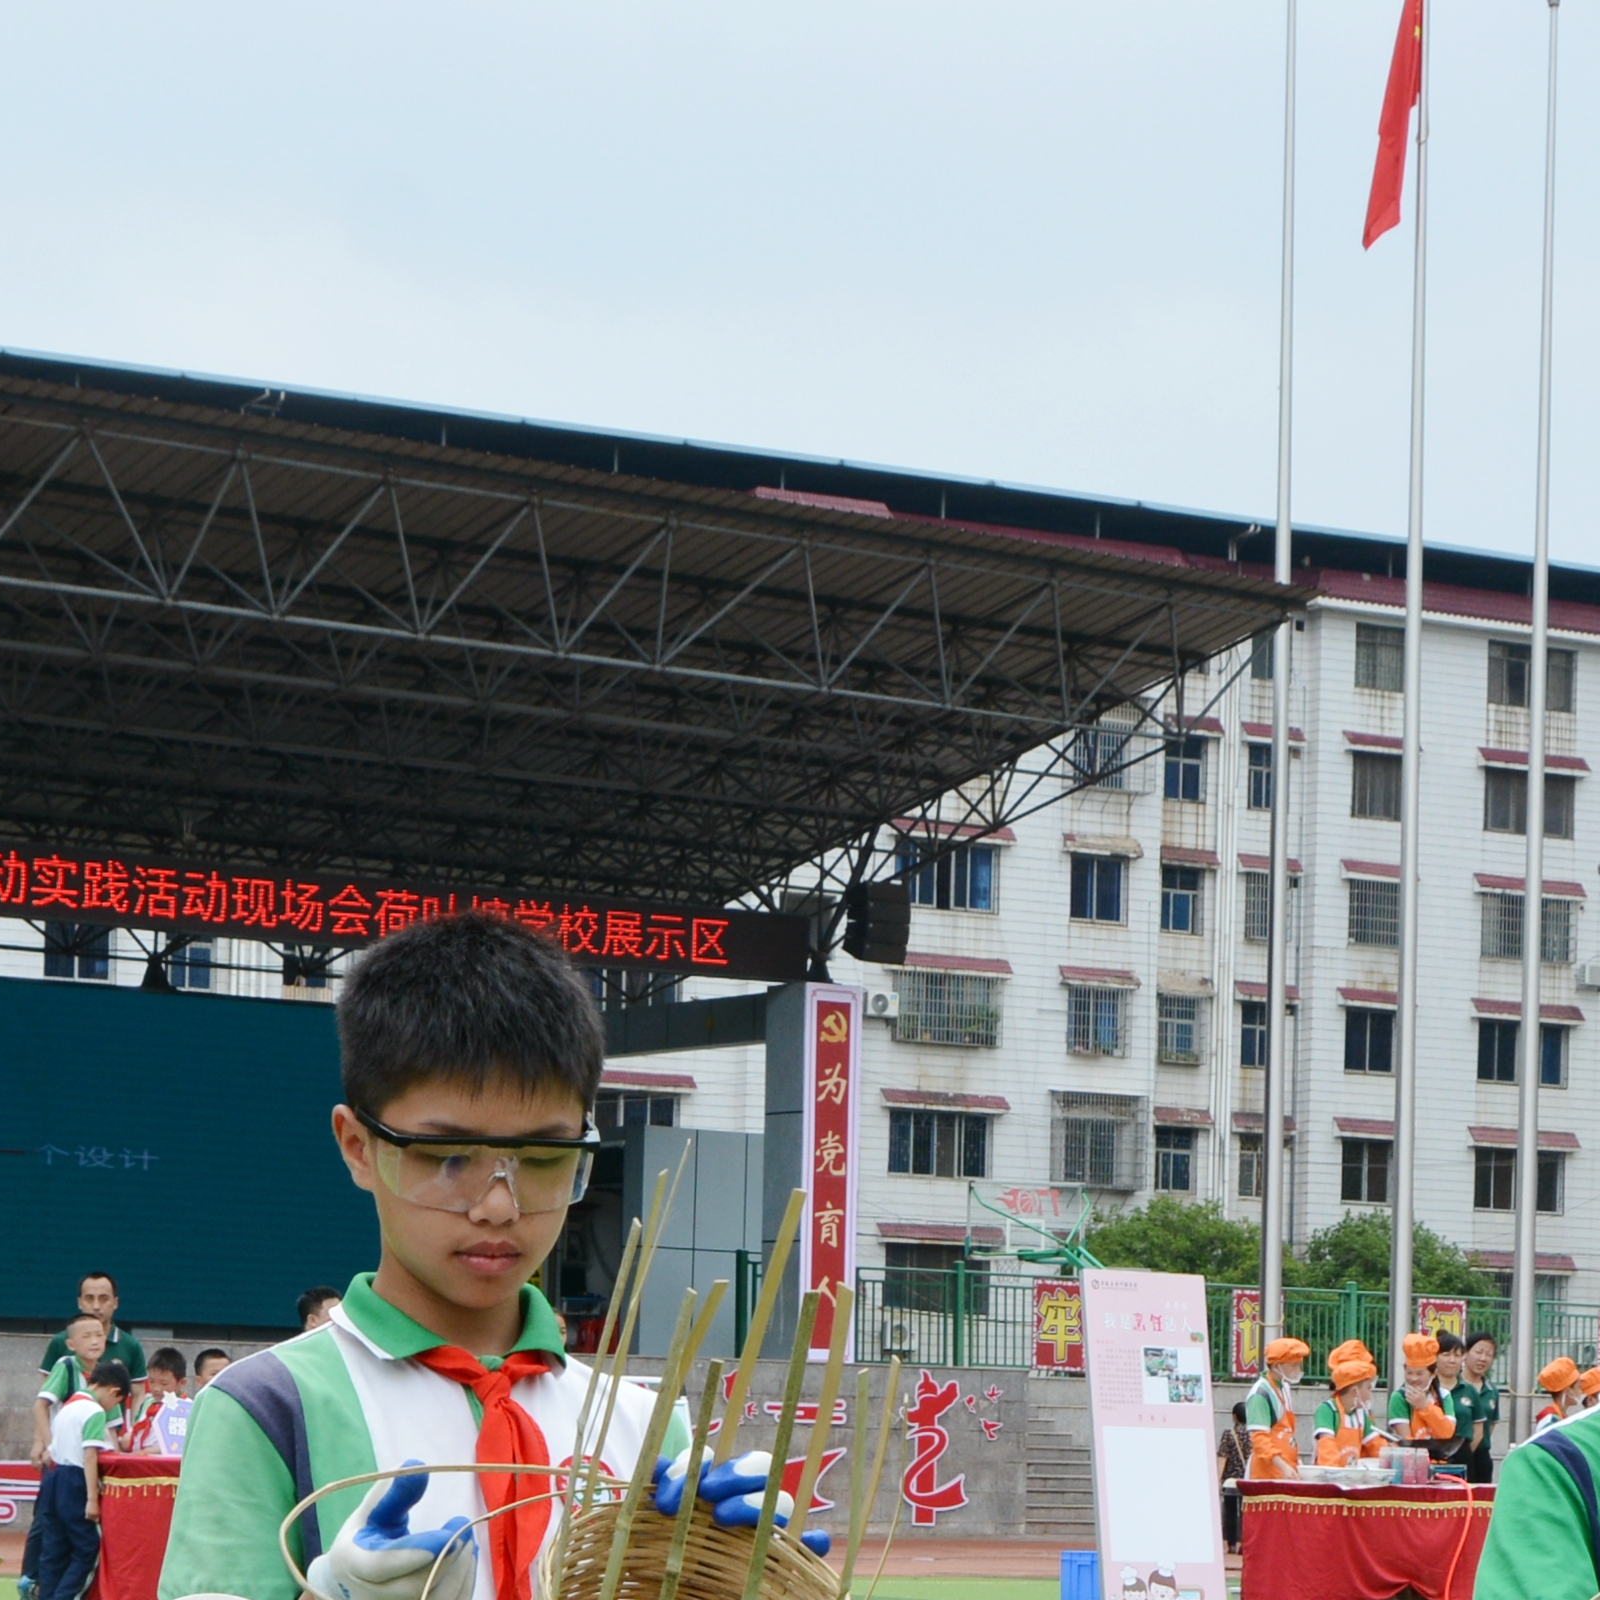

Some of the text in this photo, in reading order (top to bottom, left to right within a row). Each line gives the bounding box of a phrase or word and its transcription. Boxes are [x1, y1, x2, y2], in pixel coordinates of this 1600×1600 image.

[814, 1063, 848, 1308] 为党育人
[1037, 1290, 1083, 1362] 牢
[1104, 1311, 1192, 1333] 我是烹饪达人
